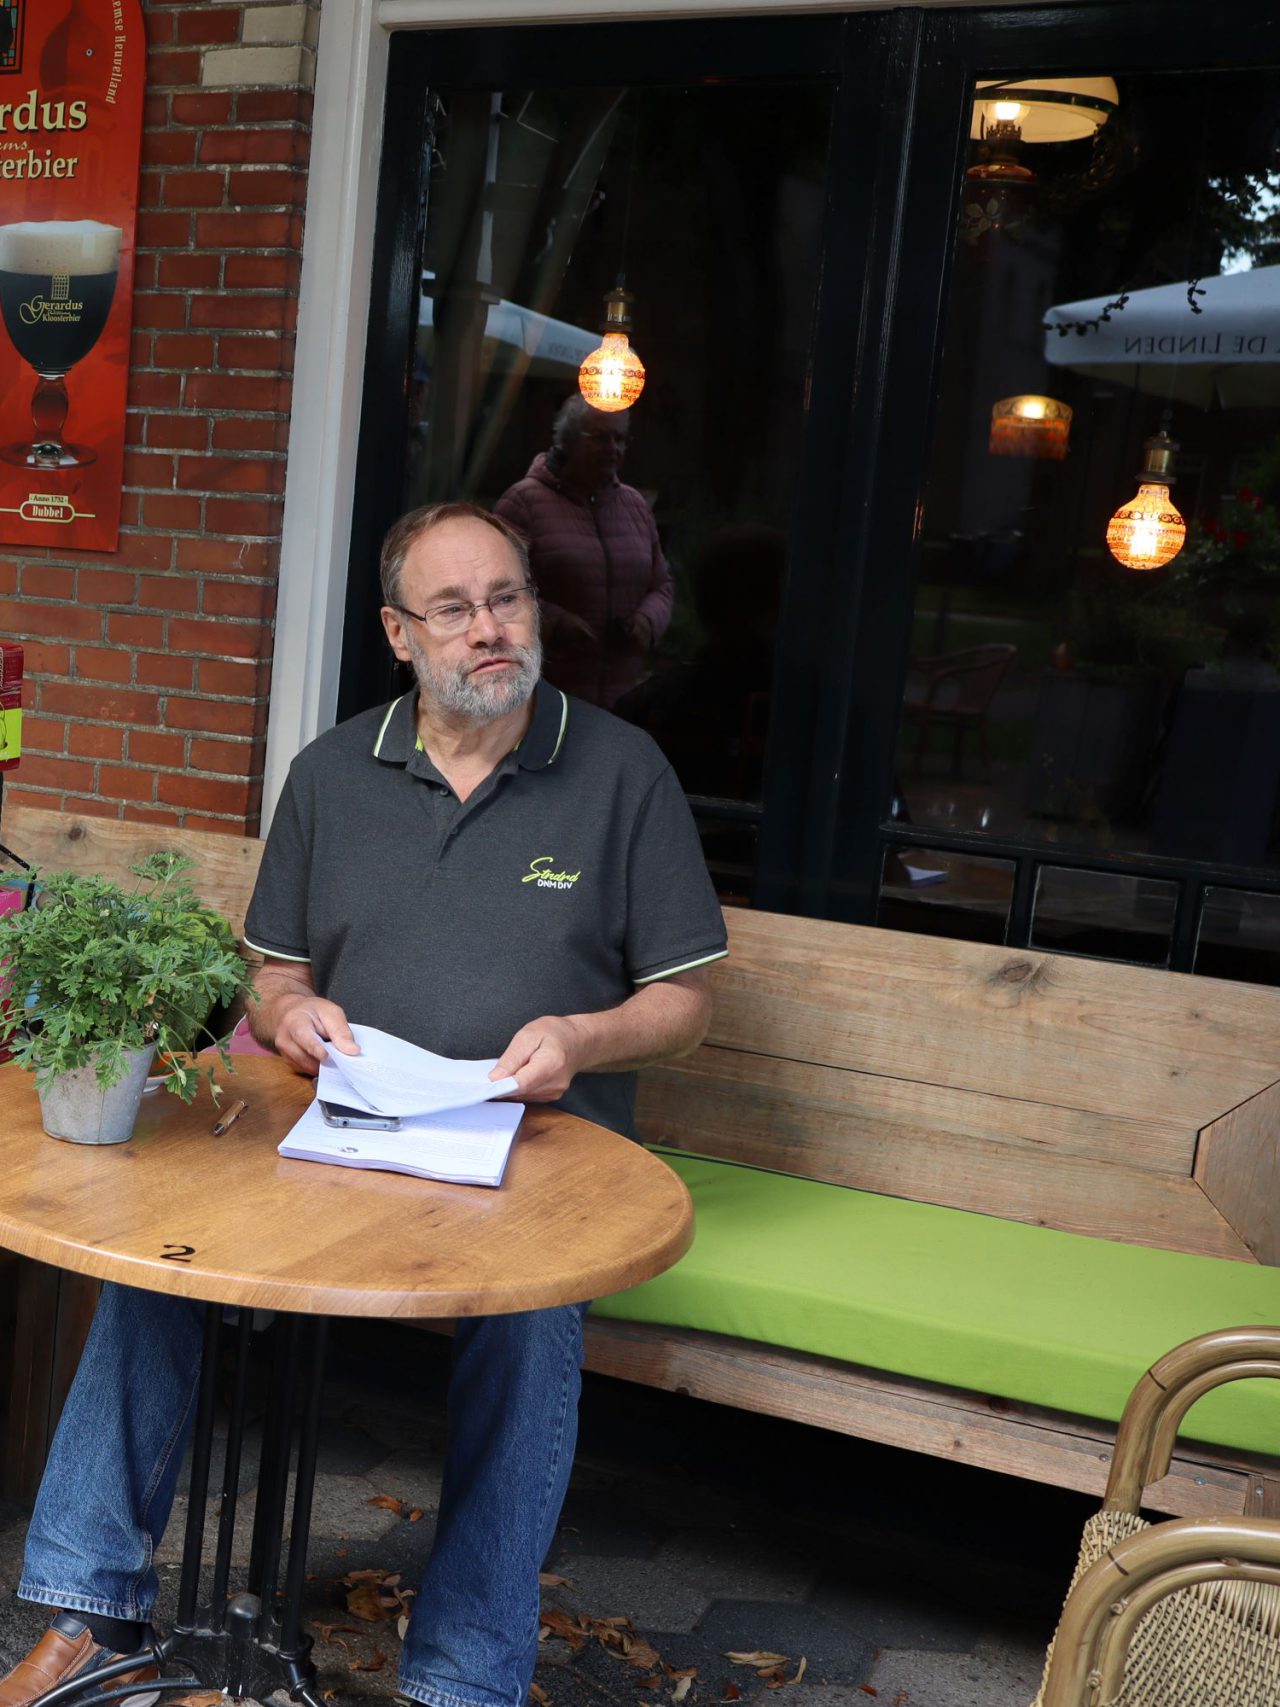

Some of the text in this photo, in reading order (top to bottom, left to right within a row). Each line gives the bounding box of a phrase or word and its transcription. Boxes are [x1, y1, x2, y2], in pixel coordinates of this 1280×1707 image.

[112, 0, 124, 32] emse
[32, 505, 63, 518] Dubbel
[537, 879, 573, 889] DNM DIV
[159, 1244, 196, 1263] 2
